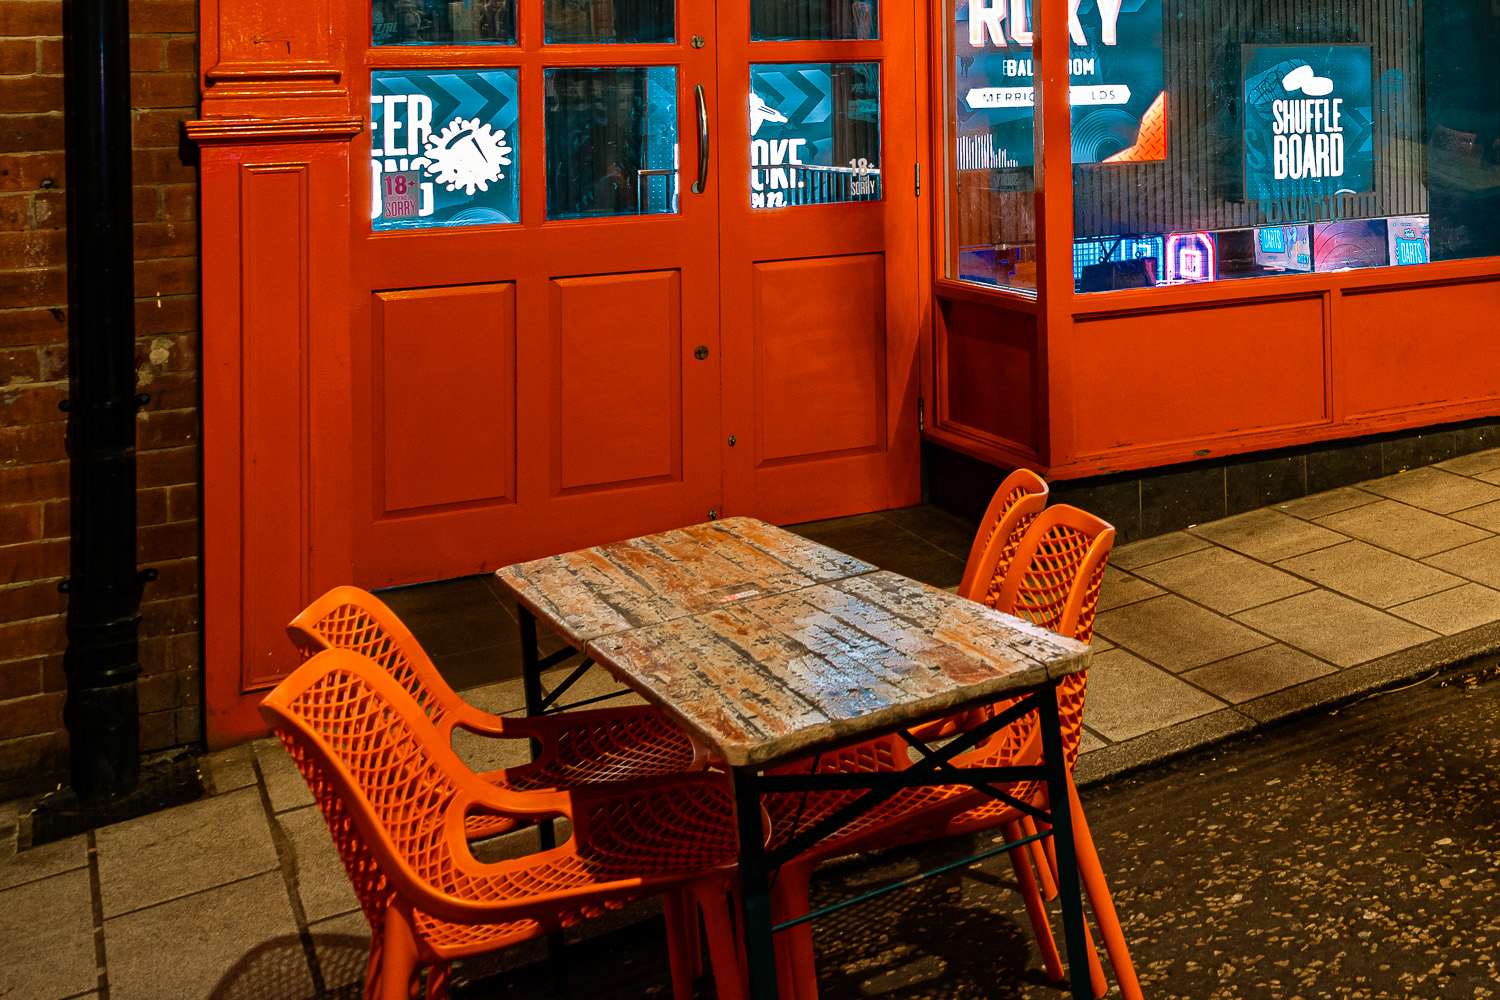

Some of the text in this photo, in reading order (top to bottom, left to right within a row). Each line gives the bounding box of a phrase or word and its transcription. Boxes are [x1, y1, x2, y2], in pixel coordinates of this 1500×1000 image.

[1272, 98, 1344, 135] SHUFFLE
[1273, 132, 1345, 180] BOARD
[849, 158, 875, 177] 18+
[383, 174, 416, 196] 18+
[850, 180, 876, 196] SORRY
[384, 200, 416, 218] SORRY
[1263, 229, 1282, 250] DARTS
[1400, 242, 1423, 264] DARTS
